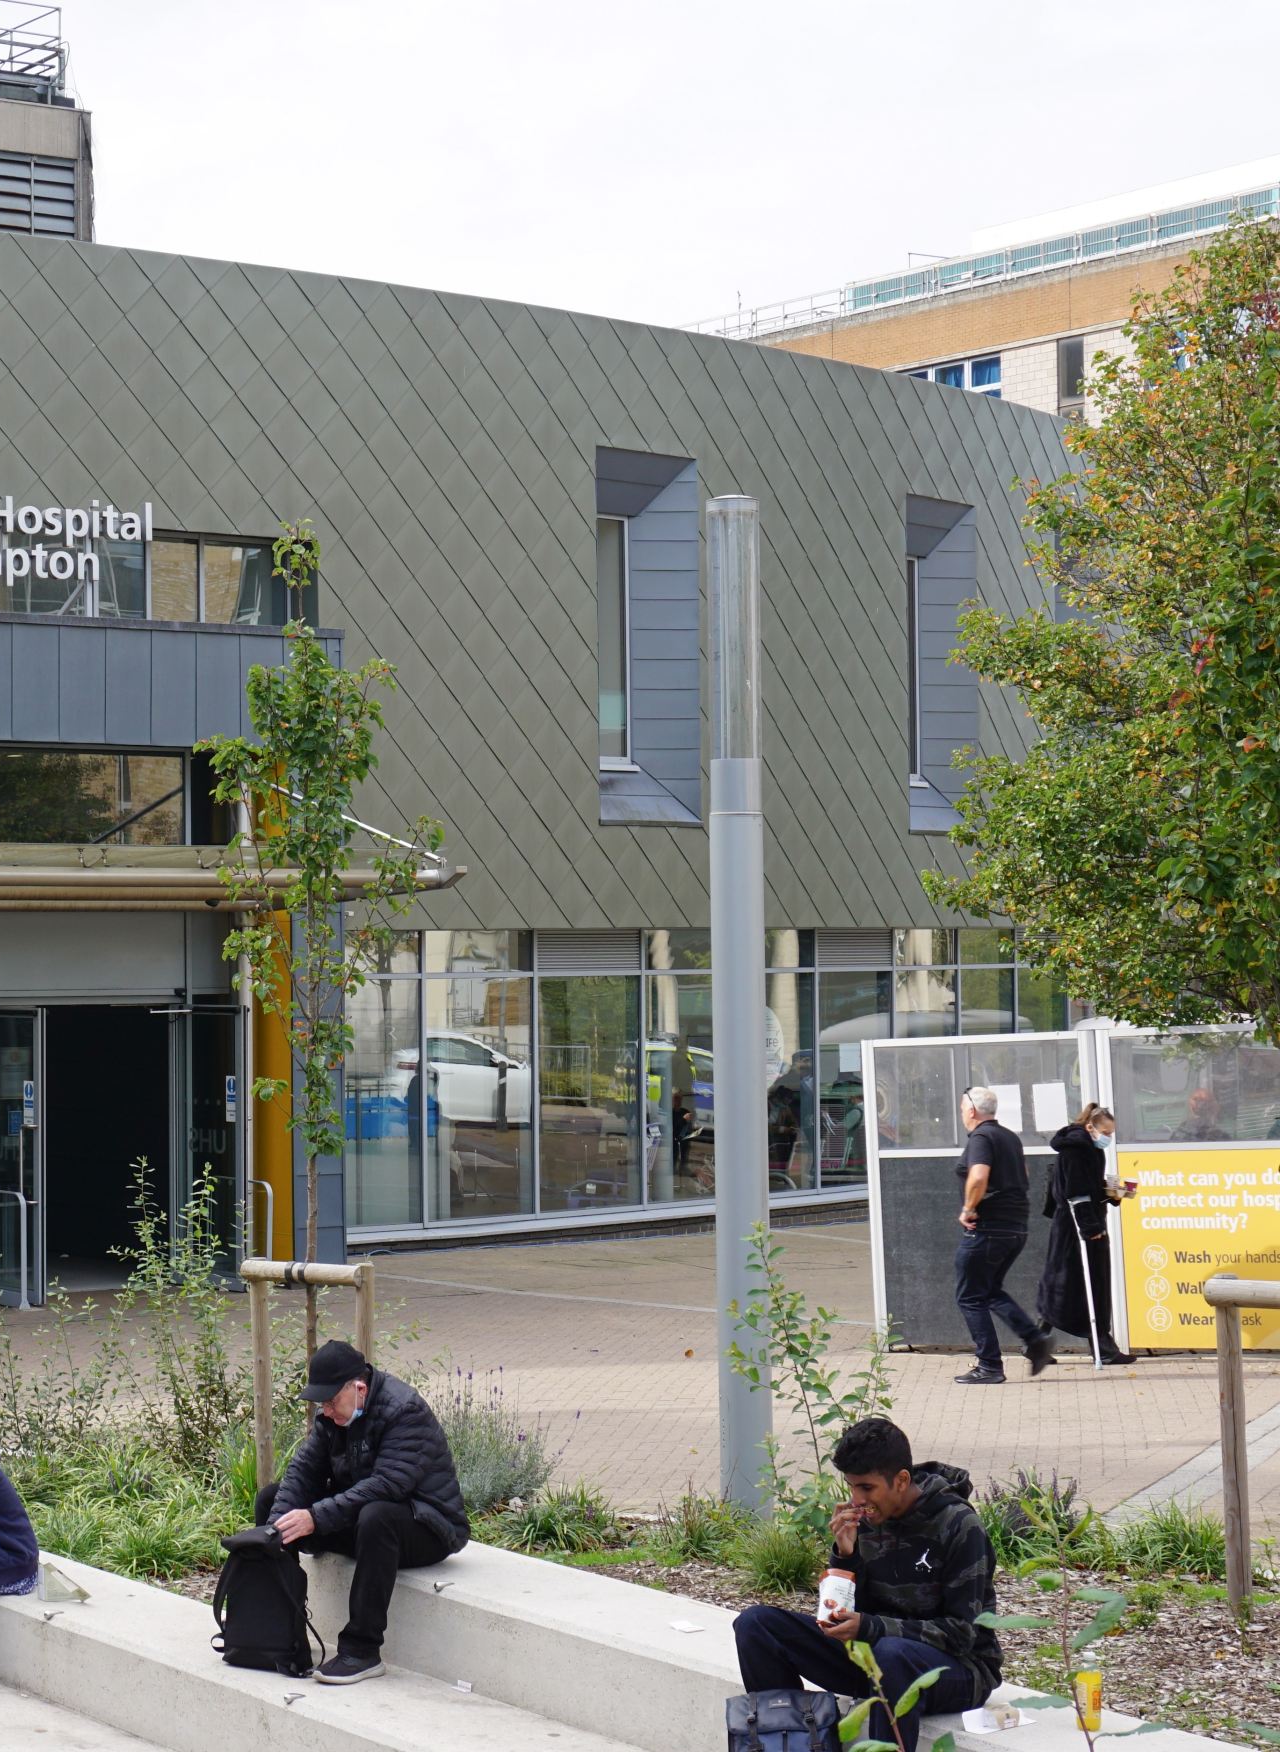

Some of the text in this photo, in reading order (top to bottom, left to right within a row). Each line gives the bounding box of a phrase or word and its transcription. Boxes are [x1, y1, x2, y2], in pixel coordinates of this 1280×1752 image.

[1138, 1170, 1184, 1187] What
[1188, 1173, 1219, 1187] can
[1223, 1172, 1257, 1190] you
[1140, 1193, 1204, 1211] protect
[1208, 1194, 1238, 1207] our
[1141, 1212, 1248, 1233] community?
[1174, 1250, 1211, 1264] Wash
[1214, 1253, 1241, 1267] your
[1176, 1281, 1206, 1294] Wal
[1178, 1312, 1262, 1326] Wear ask
